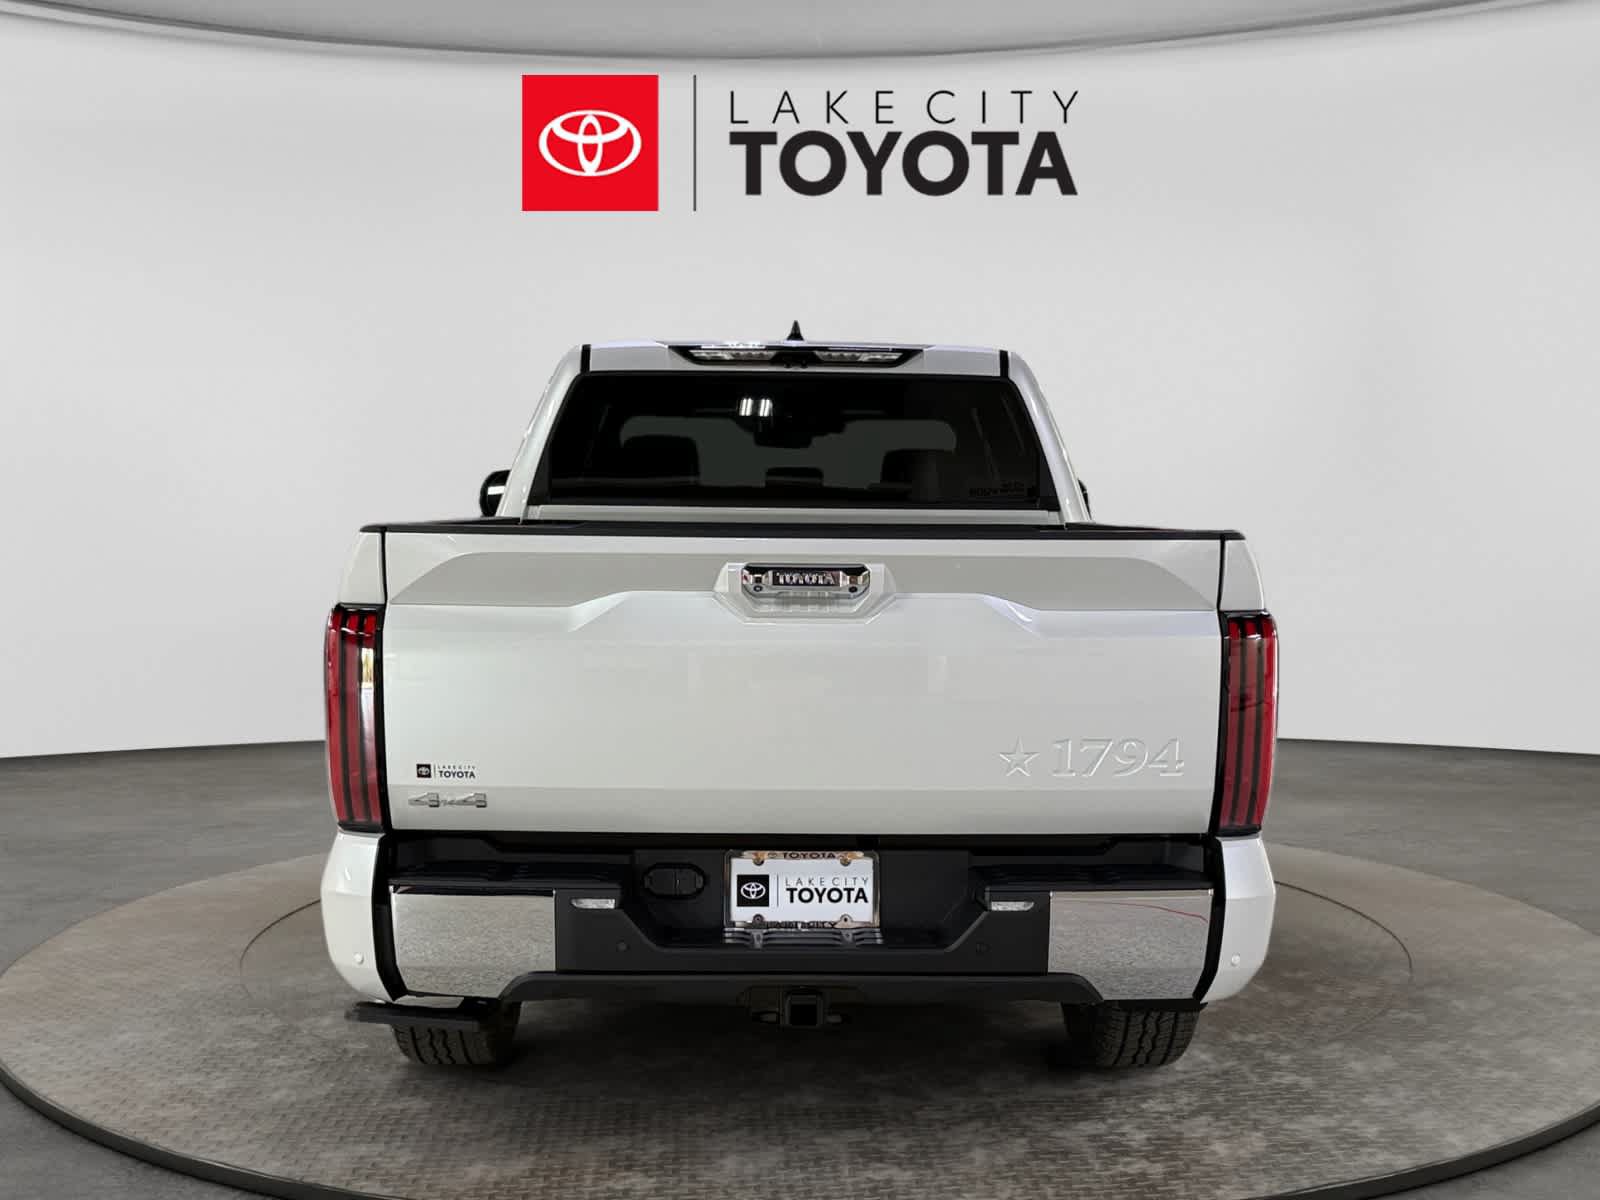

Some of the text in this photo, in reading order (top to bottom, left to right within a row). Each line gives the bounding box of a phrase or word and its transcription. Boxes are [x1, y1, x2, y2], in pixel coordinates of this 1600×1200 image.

[776, 571, 836, 586] TOYOTA
[1051, 736, 1185, 778] 1794
[438, 770, 476, 779] TOYOTA
[783, 851, 836, 859] TOYOTA
[785, 876, 869, 887] LAKE CITY
[786, 887, 869, 904] TOYOTA
